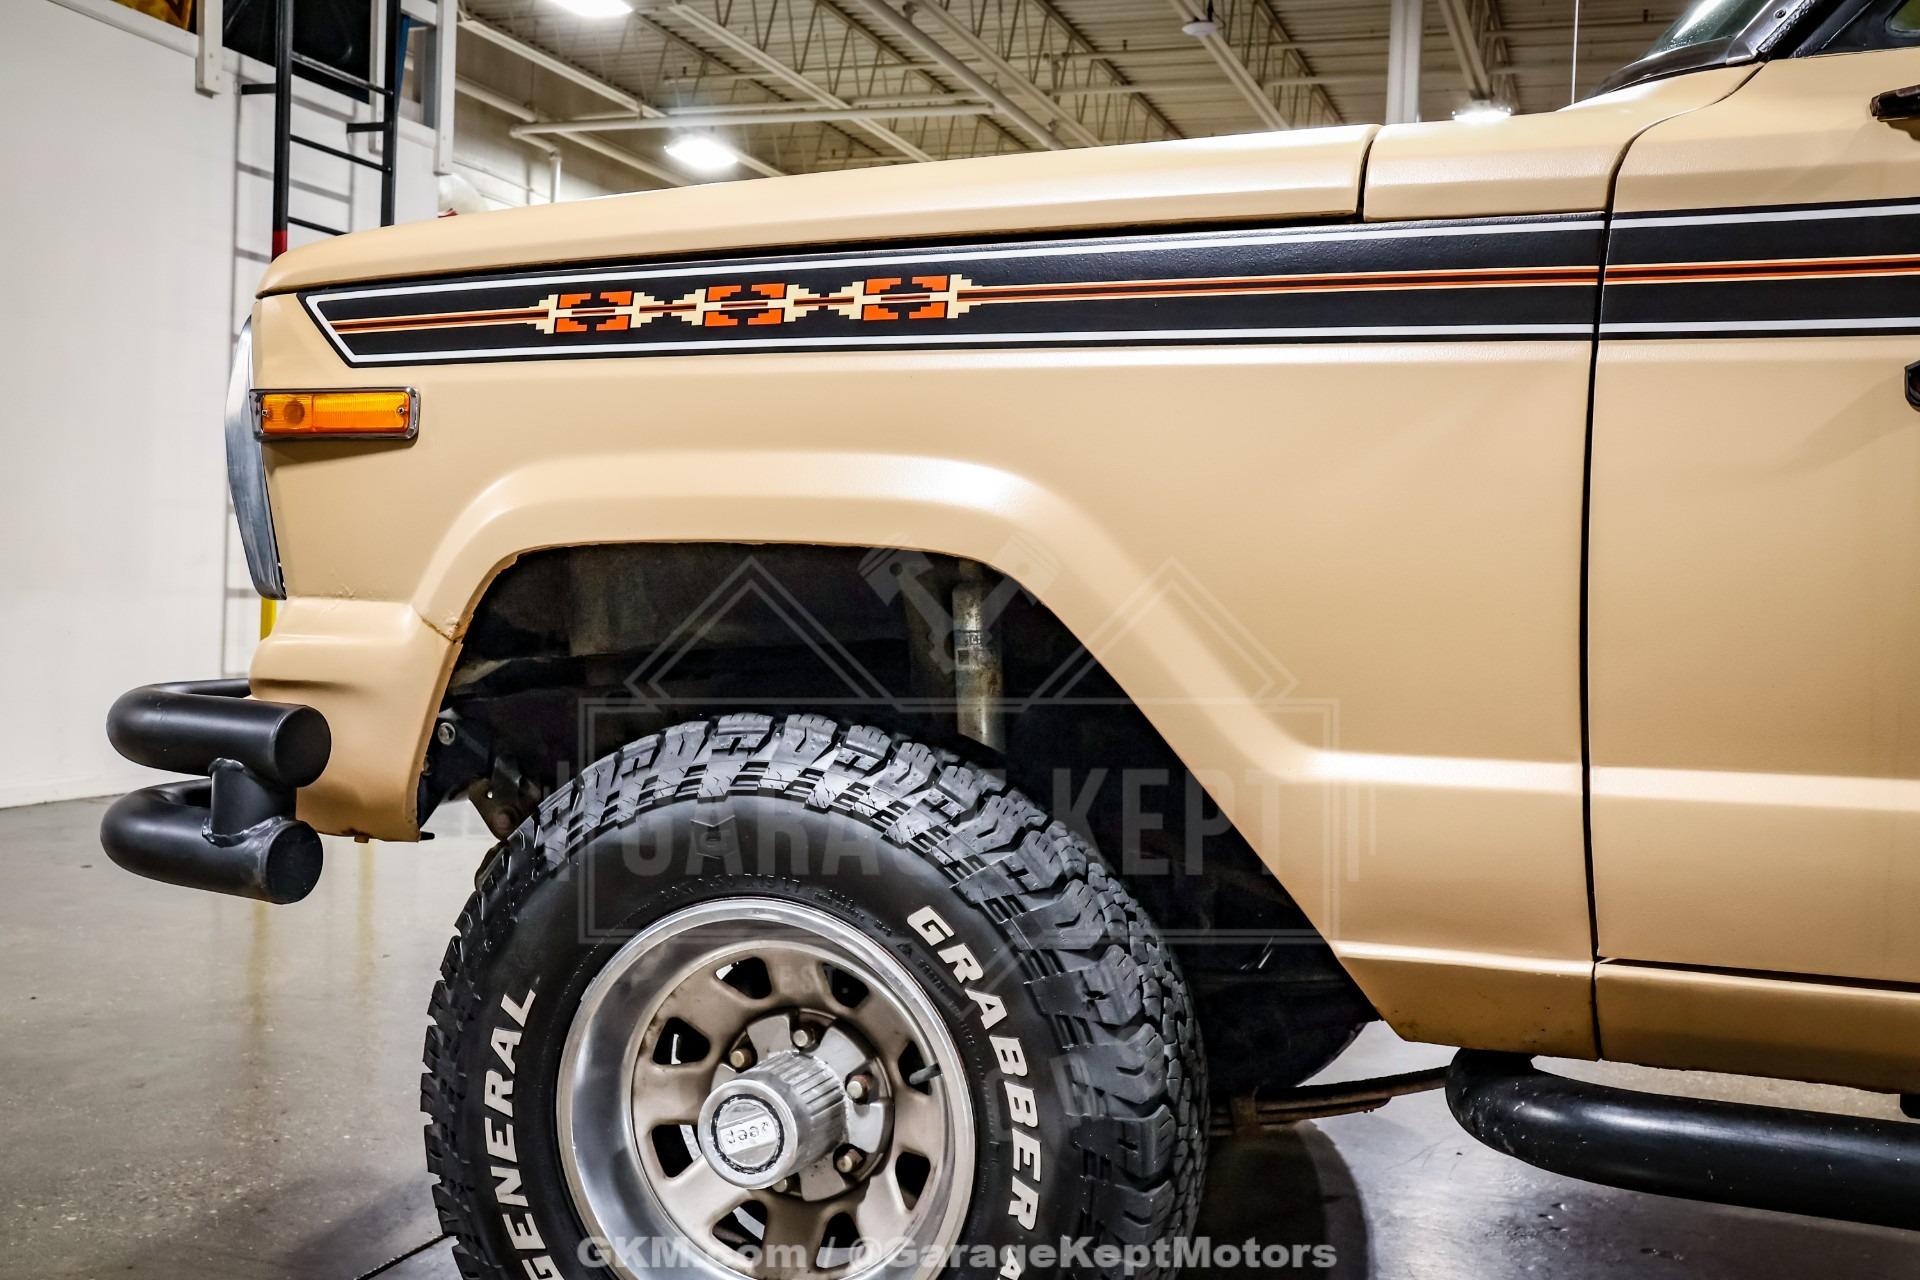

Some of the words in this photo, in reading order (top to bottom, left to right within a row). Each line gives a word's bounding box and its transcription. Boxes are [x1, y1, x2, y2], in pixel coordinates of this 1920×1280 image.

[484, 988, 565, 1280] GENERAL
[906, 905, 1042, 1231] GRABBER
[997, 1247, 1021, 1280] A
